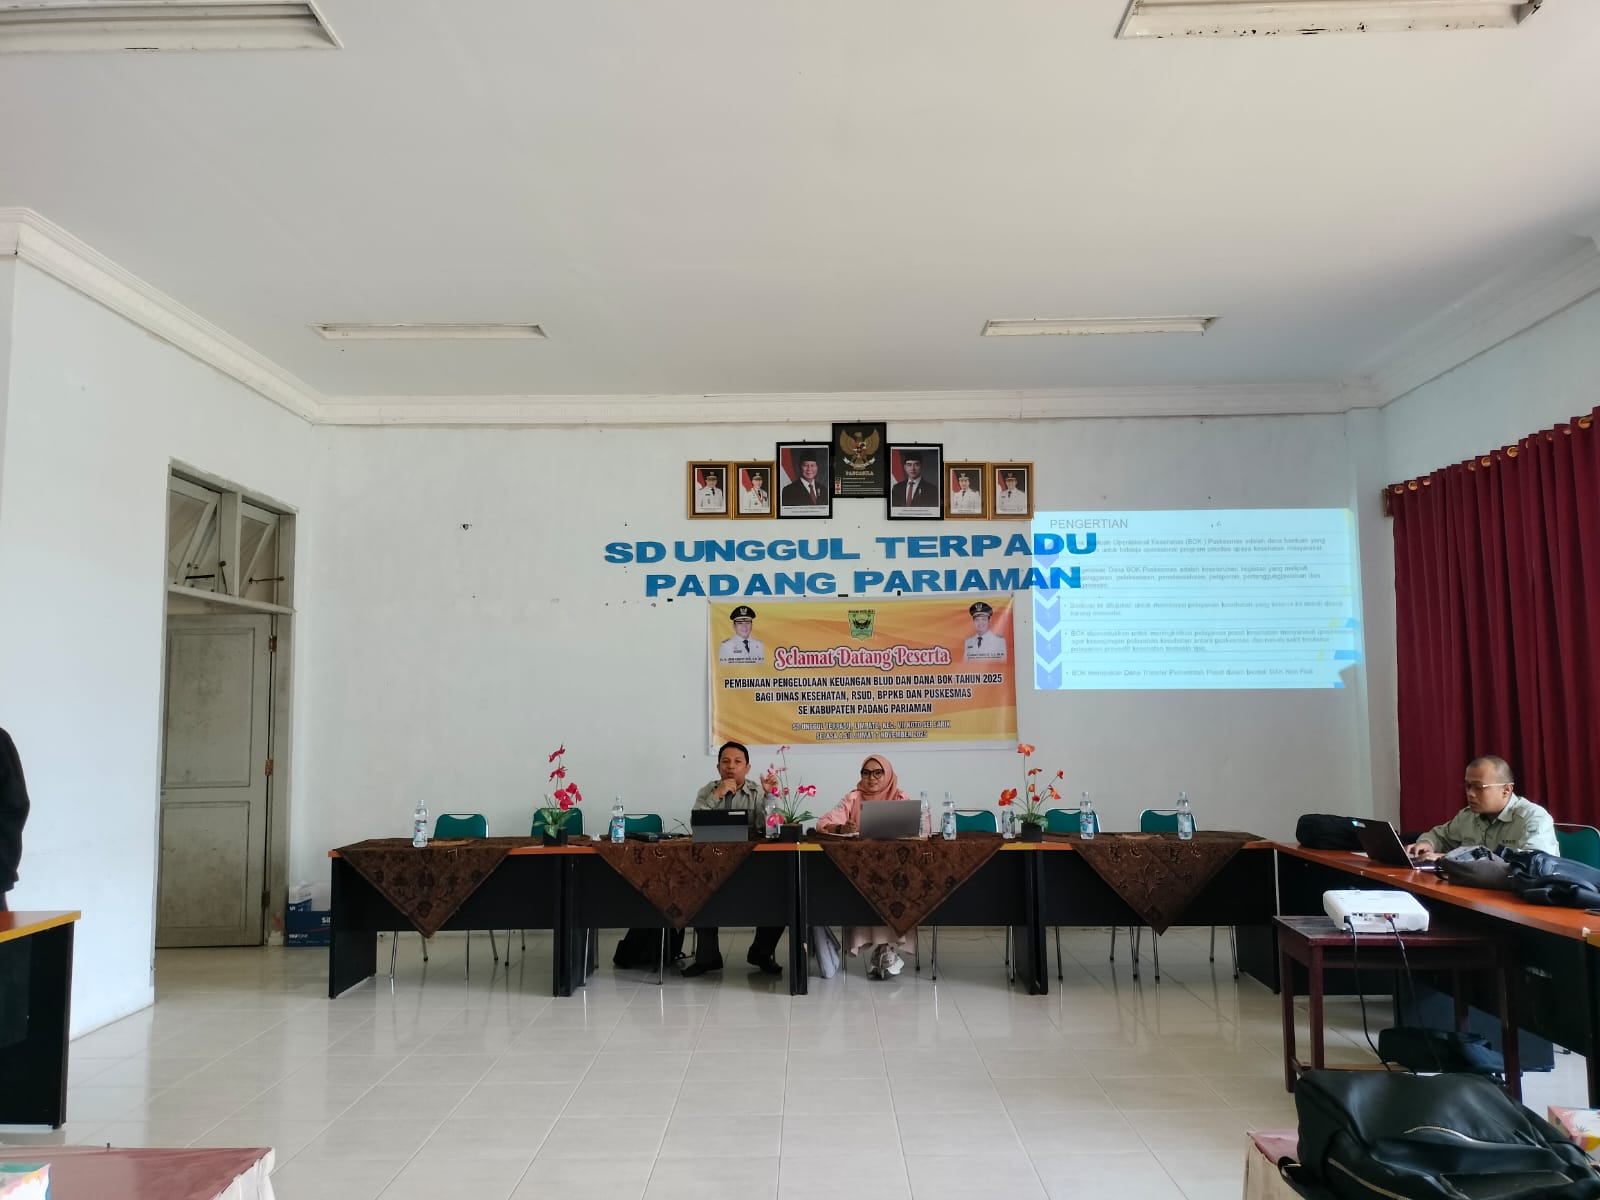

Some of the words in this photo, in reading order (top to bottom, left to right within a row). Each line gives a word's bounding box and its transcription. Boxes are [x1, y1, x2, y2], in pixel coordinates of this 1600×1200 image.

[1050, 518, 1128, 529] PENGERTIAN
[604, 541, 667, 563] SD
[675, 538, 860, 562] UNGGUL
[876, 532, 1096, 559] TERPADU
[646, 571, 837, 597] PADANG
[854, 566, 1081, 593] PARIAMAN
[775, 647, 834, 669] Selamat
[838, 647, 892, 669] Datang
[894, 646, 950, 665] Peserta
[724, 679, 771, 688] PEMBINAAN
[773, 678, 828, 688] PENGELOLAAN
[830, 676, 871, 687] KEUANGAN
[873, 675, 893, 685] BLUD
[895, 675, 912, 685] DAN
[913, 674, 935, 685] DANA
[937, 674, 952, 684] BOK
[955, 674, 981, 684] TAHUN
[983, 673, 1002, 683] 2025
[755, 692, 774, 701] BAGI
[776, 692, 800, 701] DINAS
[801, 691, 849, 702] KESEHATAN,
[851, 690, 875, 701] RSUD,
[877, 689, 904, 700] BPPKB
[906, 689, 922, 699] DAN
[924, 688, 972, 698] PUSKESMAS
[798, 706, 808, 715] SE
[810, 704, 856, 715] KABUPATEN
[858, 703, 889, 714] PADANG
[890, 703, 932, 713] PARIAMAN
[906, 721, 922, 729] KOTO
[880, 730, 912, 739] NOVEMBER
[913, 730, 928, 738] 2025
